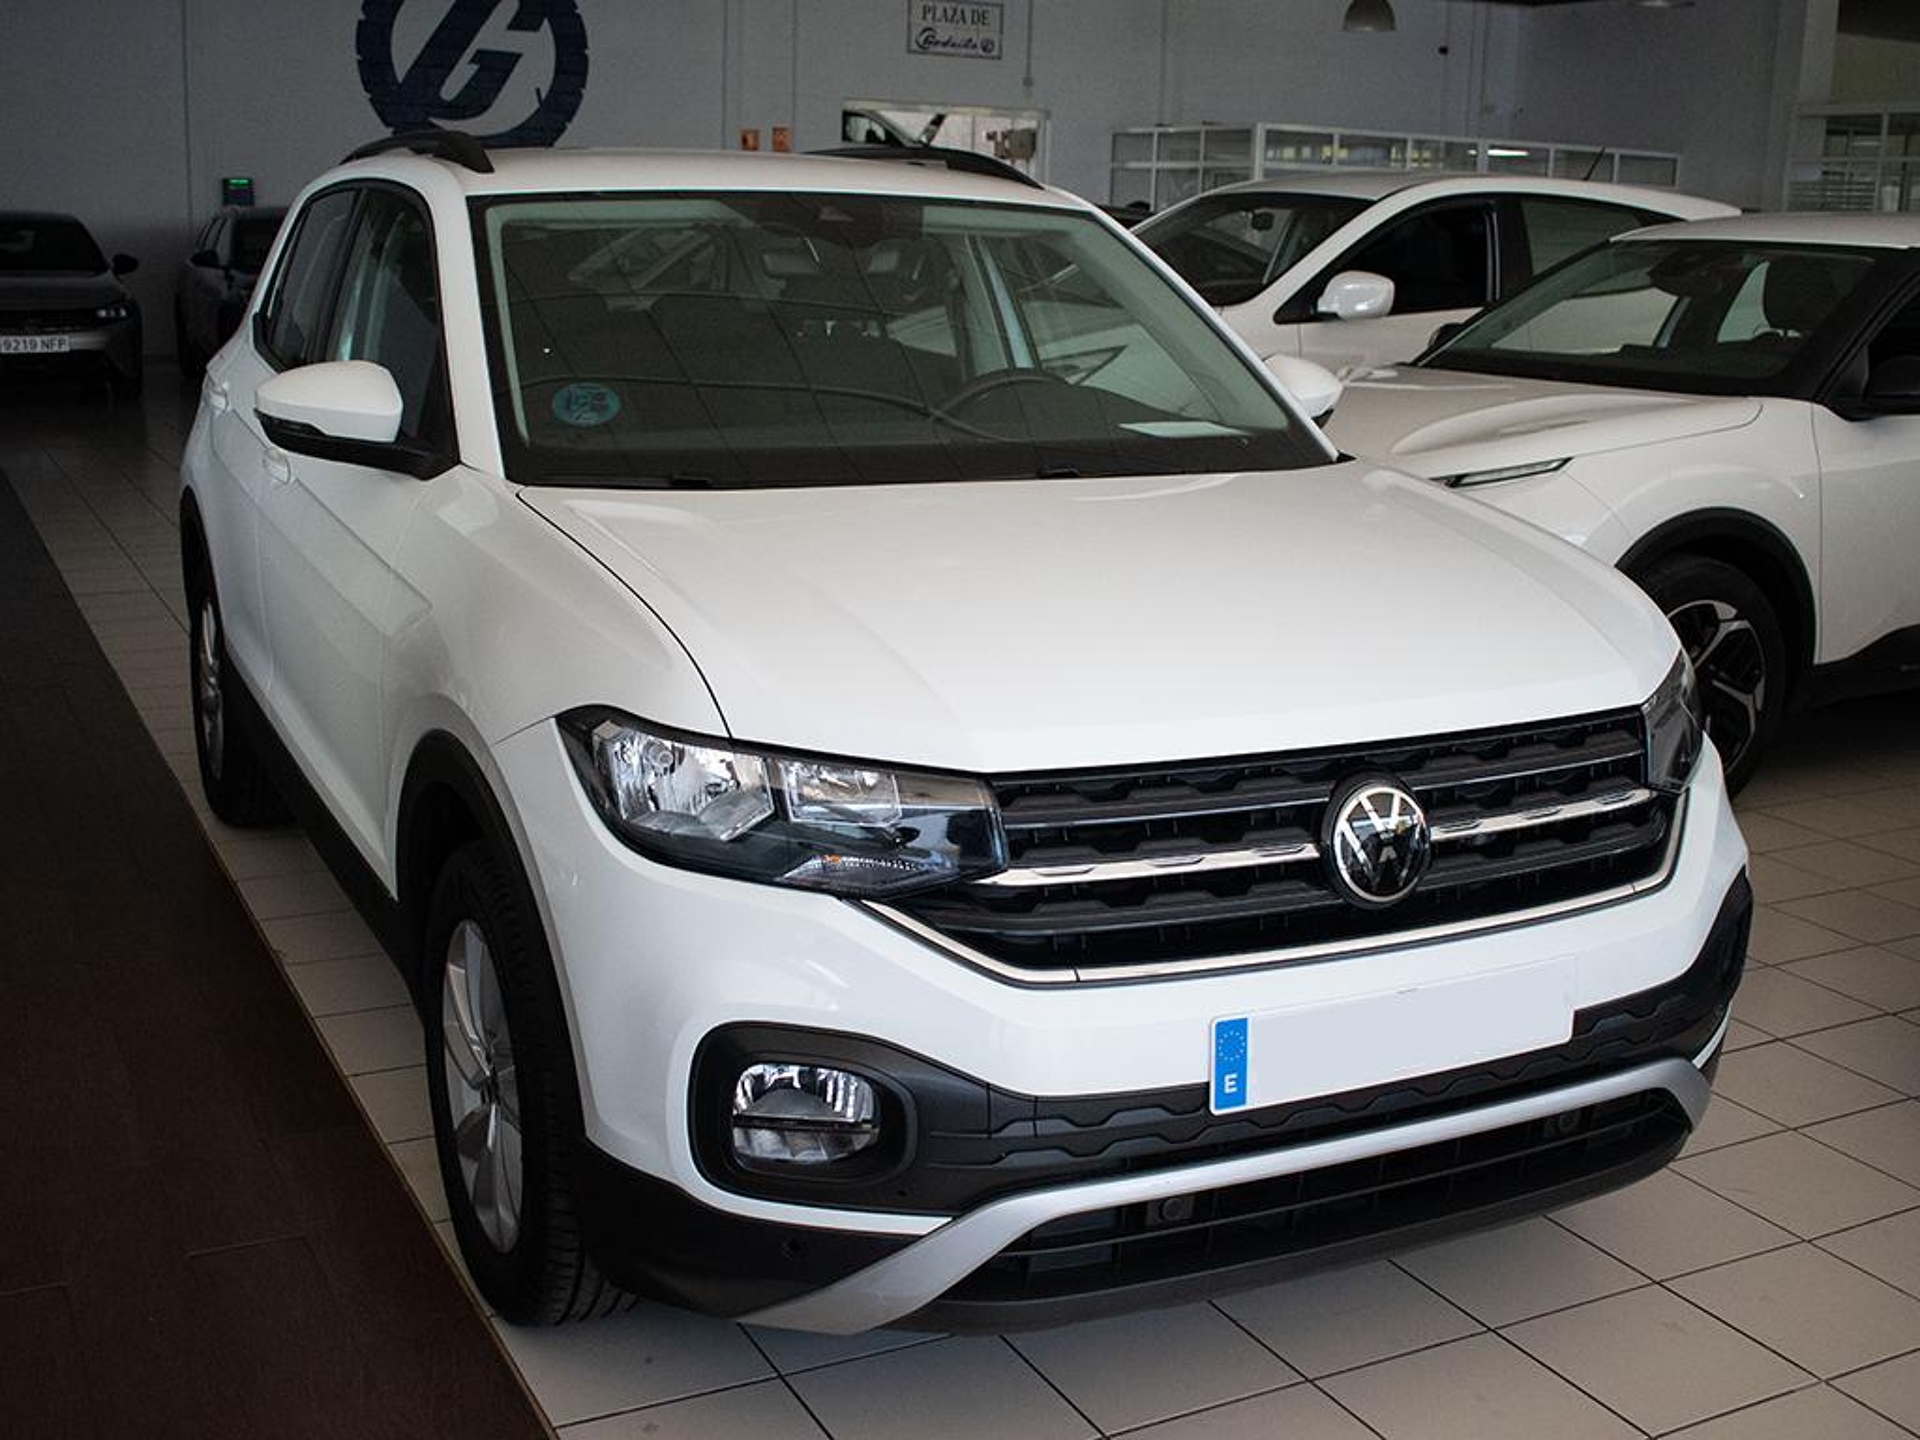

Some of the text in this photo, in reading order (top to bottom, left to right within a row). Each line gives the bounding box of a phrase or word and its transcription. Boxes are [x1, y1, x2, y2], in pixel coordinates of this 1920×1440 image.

[922, 4, 991, 26] PLAZA DE
[1224, 1073, 1238, 1095] E
